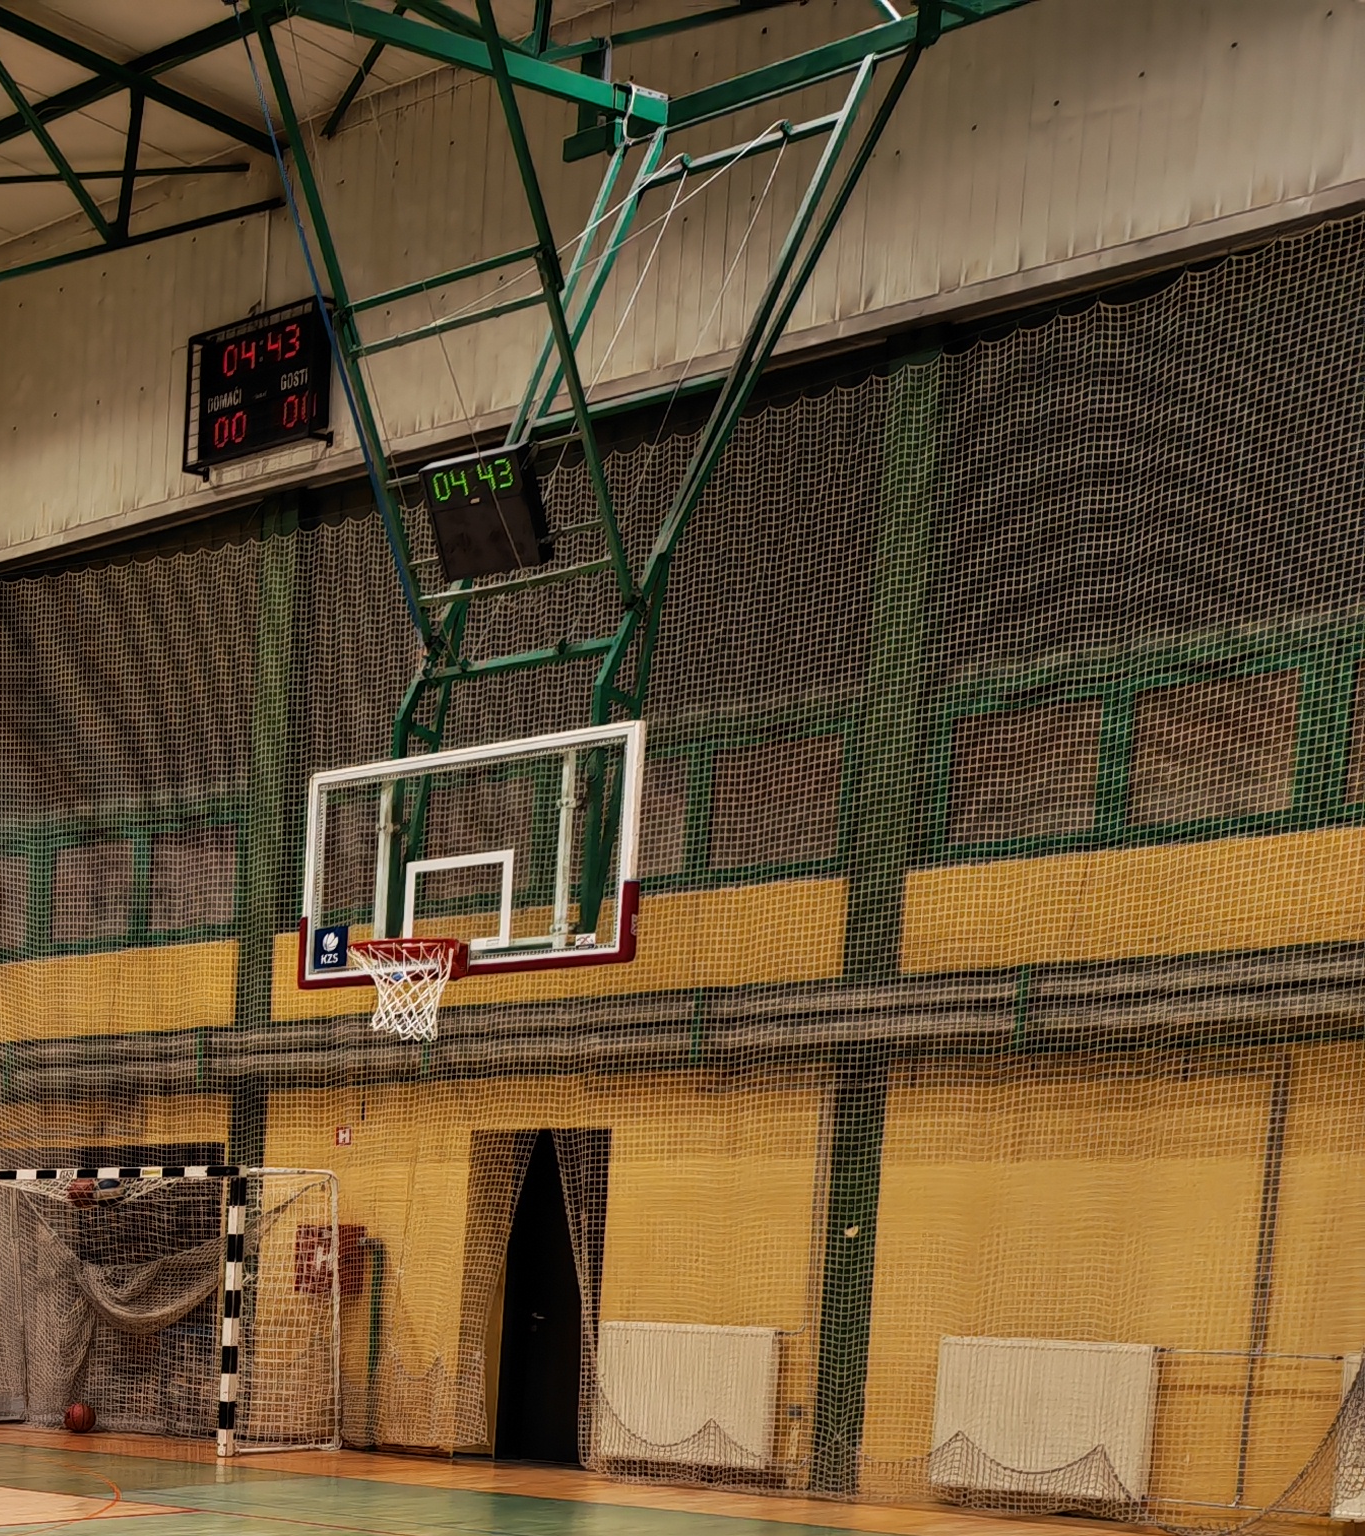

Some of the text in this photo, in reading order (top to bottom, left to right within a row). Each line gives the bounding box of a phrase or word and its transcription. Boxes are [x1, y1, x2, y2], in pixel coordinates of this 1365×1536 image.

[223, 323, 300, 377] 04:43
[281, 367, 309, 391] GOSTI
[214, 410, 247, 448] 00
[320, 954, 339, 965] KZS
